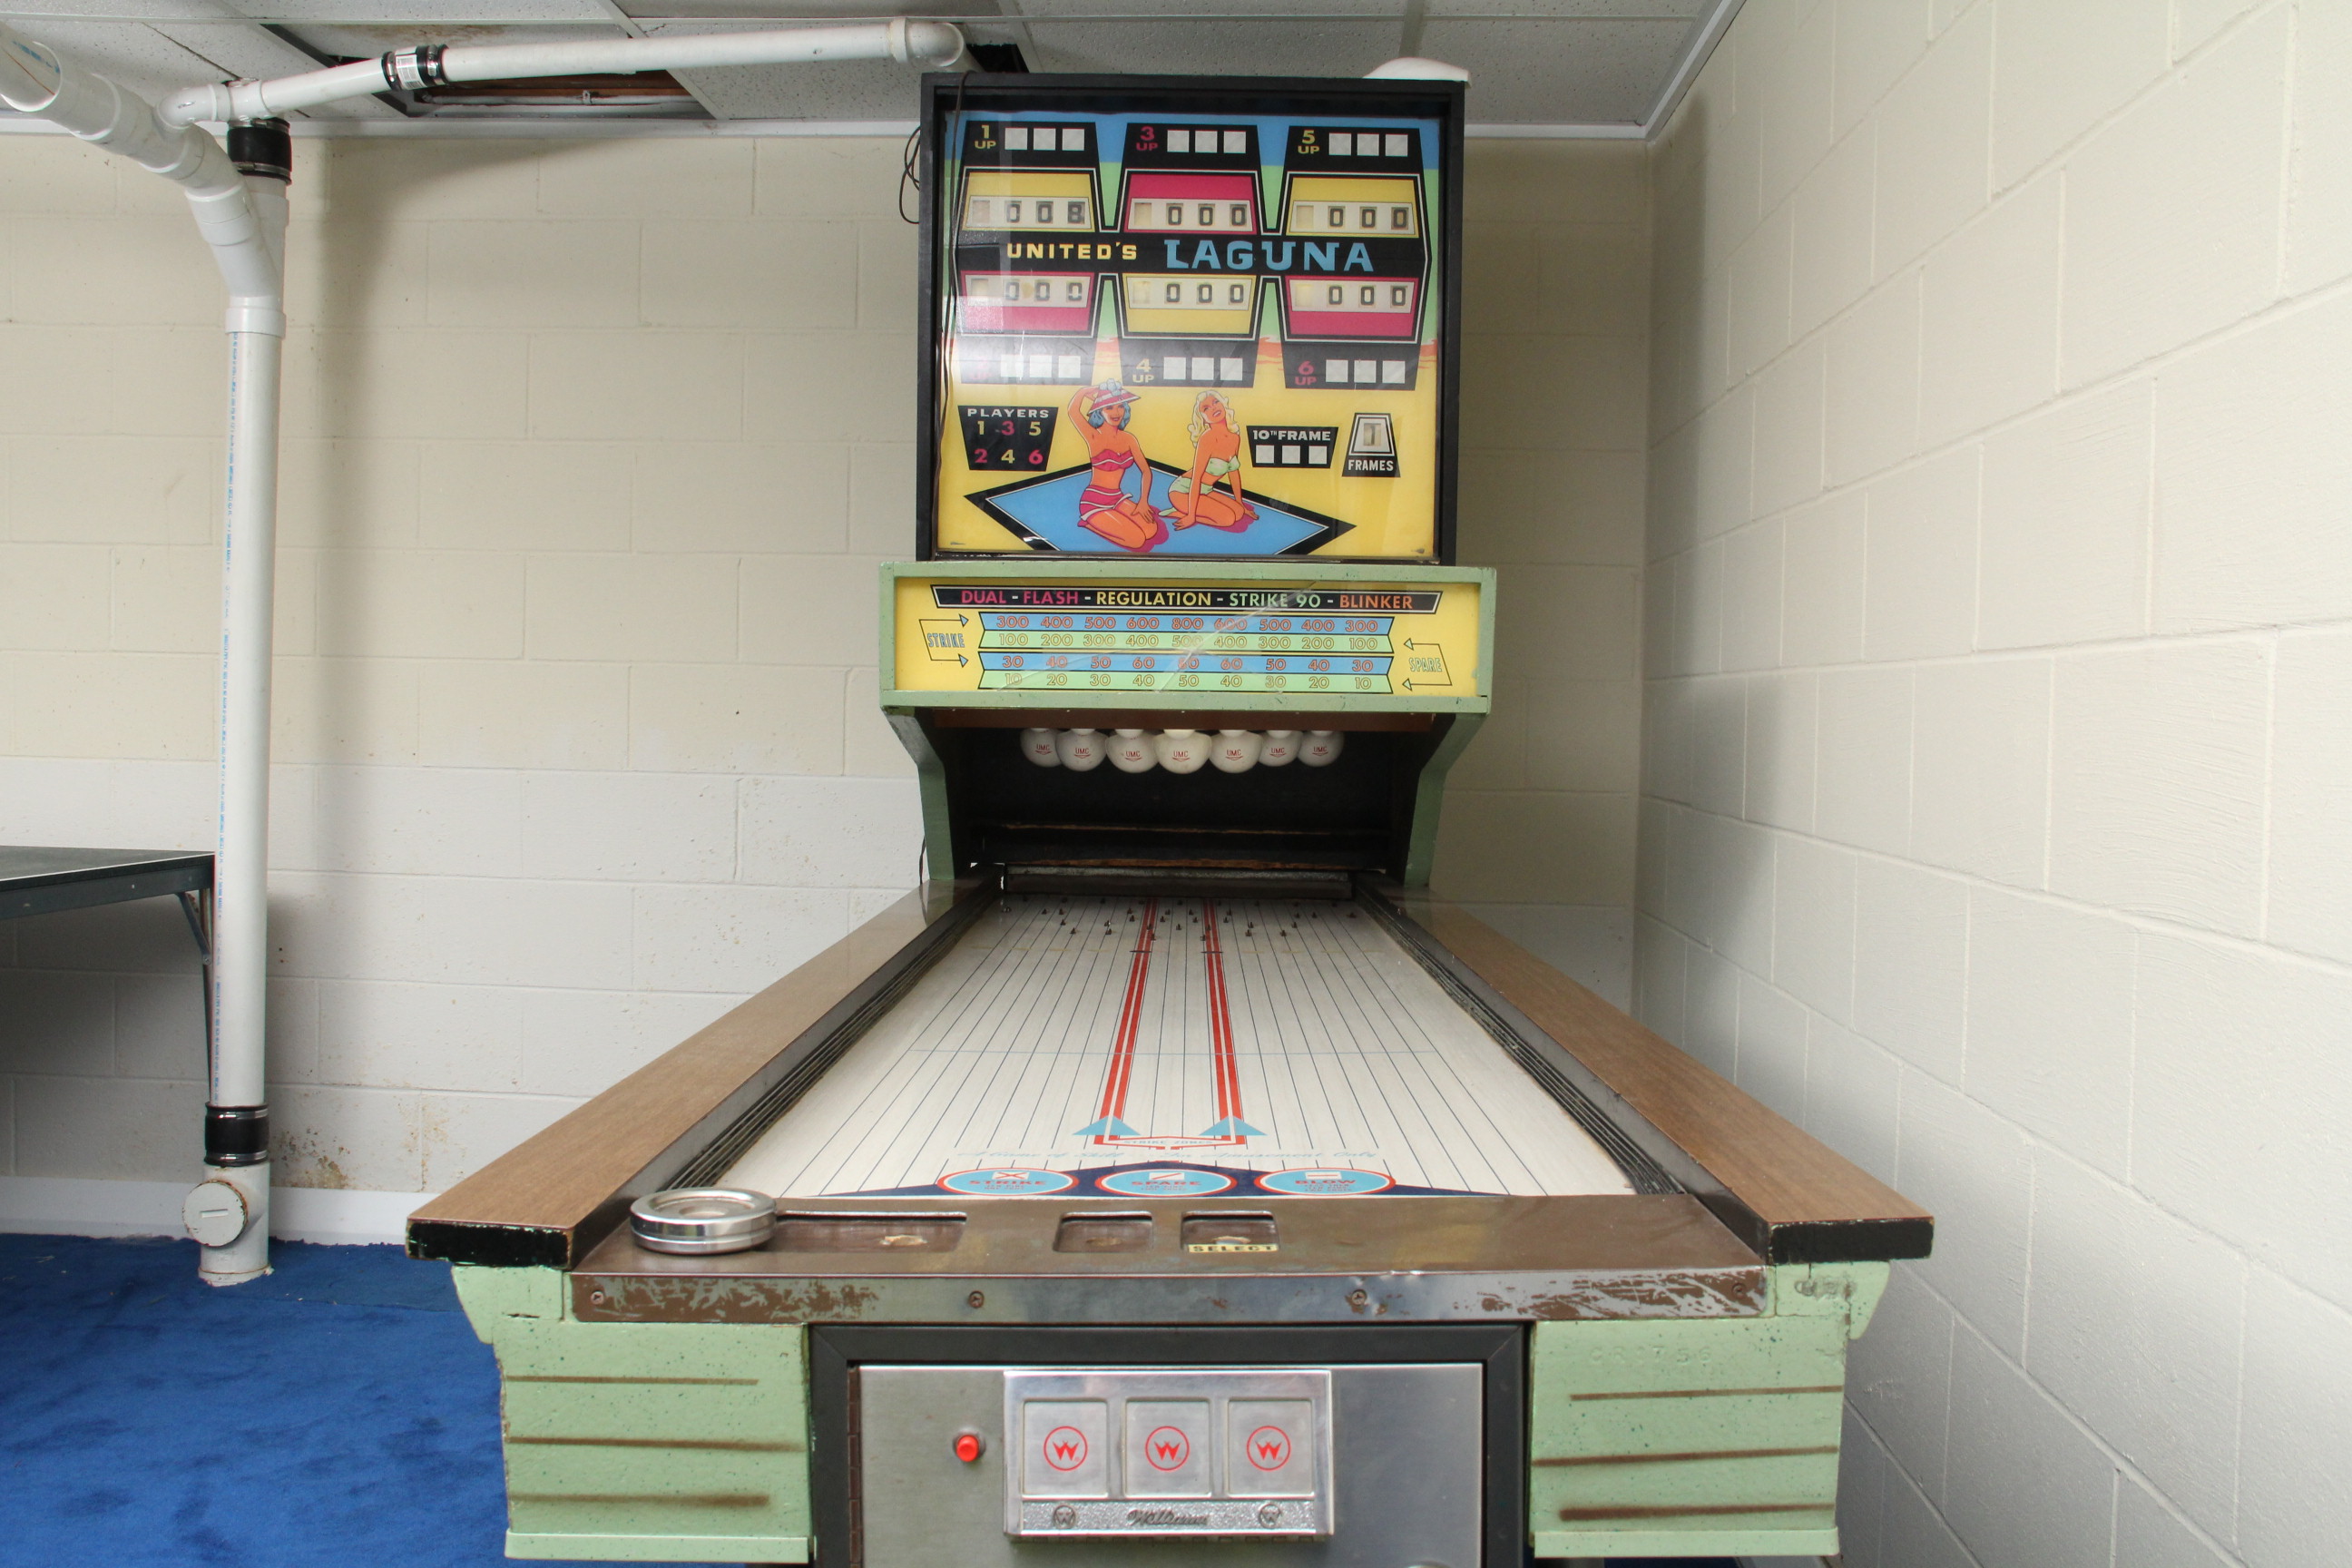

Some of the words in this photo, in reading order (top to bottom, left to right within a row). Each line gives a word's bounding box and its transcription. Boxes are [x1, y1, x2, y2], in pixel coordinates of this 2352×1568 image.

[981, 124, 990, 139] 1
[1141, 126, 1154, 141] 3
[1302, 130, 1315, 143] 5
[975, 140, 996, 150] UP
[1136, 142, 1158, 152] UP
[1298, 145, 1319, 154] UP
[1007, 242, 1137, 260] UNITED'S
[1164, 240, 1374, 271] LAGUNA
[1136, 358, 1152, 371] 4
[1298, 361, 1314, 375] 6
[1132, 374, 1154, 383] UP
[1295, 377, 1317, 386] UP
[967, 408, 1049, 418] PLAYERS
[977, 421, 985, 435] 1
[1001, 420, 1014, 435] 3
[1029, 421, 1041, 436] 5
[1278, 430, 1331, 441] FRAME
[975, 448, 987, 463] 2
[1001, 449, 1014, 464] 4
[1029, 449, 1043, 465] 6
[1348, 460, 1394, 471] FRAMES
[961, 592, 1006, 603] DUAL
[1024, 592, 1078, 603] FLASH
[1096, 592, 1211, 605] REGULATION
[1230, 593, 1288, 607] STRIKE
[1297, 595, 1320, 608] 90
[1339, 595, 1413, 609] BLINKER
[996, 616, 1029, 628] 300
[1041, 616, 1073, 628] 400
[1084, 617, 1116, 629] 500
[1127, 617, 1160, 629] 600
[1171, 618, 1203, 630] 800
[1259, 619, 1291, 631] 500
[1301, 620, 1335, 632] 400
[1346, 620, 1378, 632] 300
[927, 633, 965, 648] STRIKE
[999, 633, 1028, 646] 100
[1041, 633, 1073, 646] 200
[1083, 634, 1115, 646] 300
[1126, 634, 1159, 647] 400
[1214, 635, 1247, 648] 400
[1259, 636, 1291, 649] 300
[1302, 637, 1335, 649] 200
[1349, 637, 1377, 650] 100
[1003, 656, 1024, 668] 30
[1046, 656, 1067, 668] 40
[1091, 656, 1111, 669] 50
[1132, 657, 1155, 669] 60
[1220, 658, 1242, 670] 60
[1266, 658, 1286, 671] 50
[1308, 659, 1329, 671] 40
[1352, 660, 1373, 671] 30
[1409, 657, 1442, 672] SPARE
[1005, 673, 1022, 685] 10
[1047, 673, 1067, 686] 20
[1090, 674, 1111, 686] 30
[1132, 674, 1154, 687] 40
[1179, 674, 1199, 687] 50
[1220, 674, 1242, 688] 40
[1265, 675, 1286, 688] 30
[1309, 676, 1329, 689] 20
[1355, 677, 1371, 690] 10
[1173, 750, 1188, 759] UMC
[1227, 749, 1241, 757] UMC
[1126, 1509, 1208, 1526] Williams
